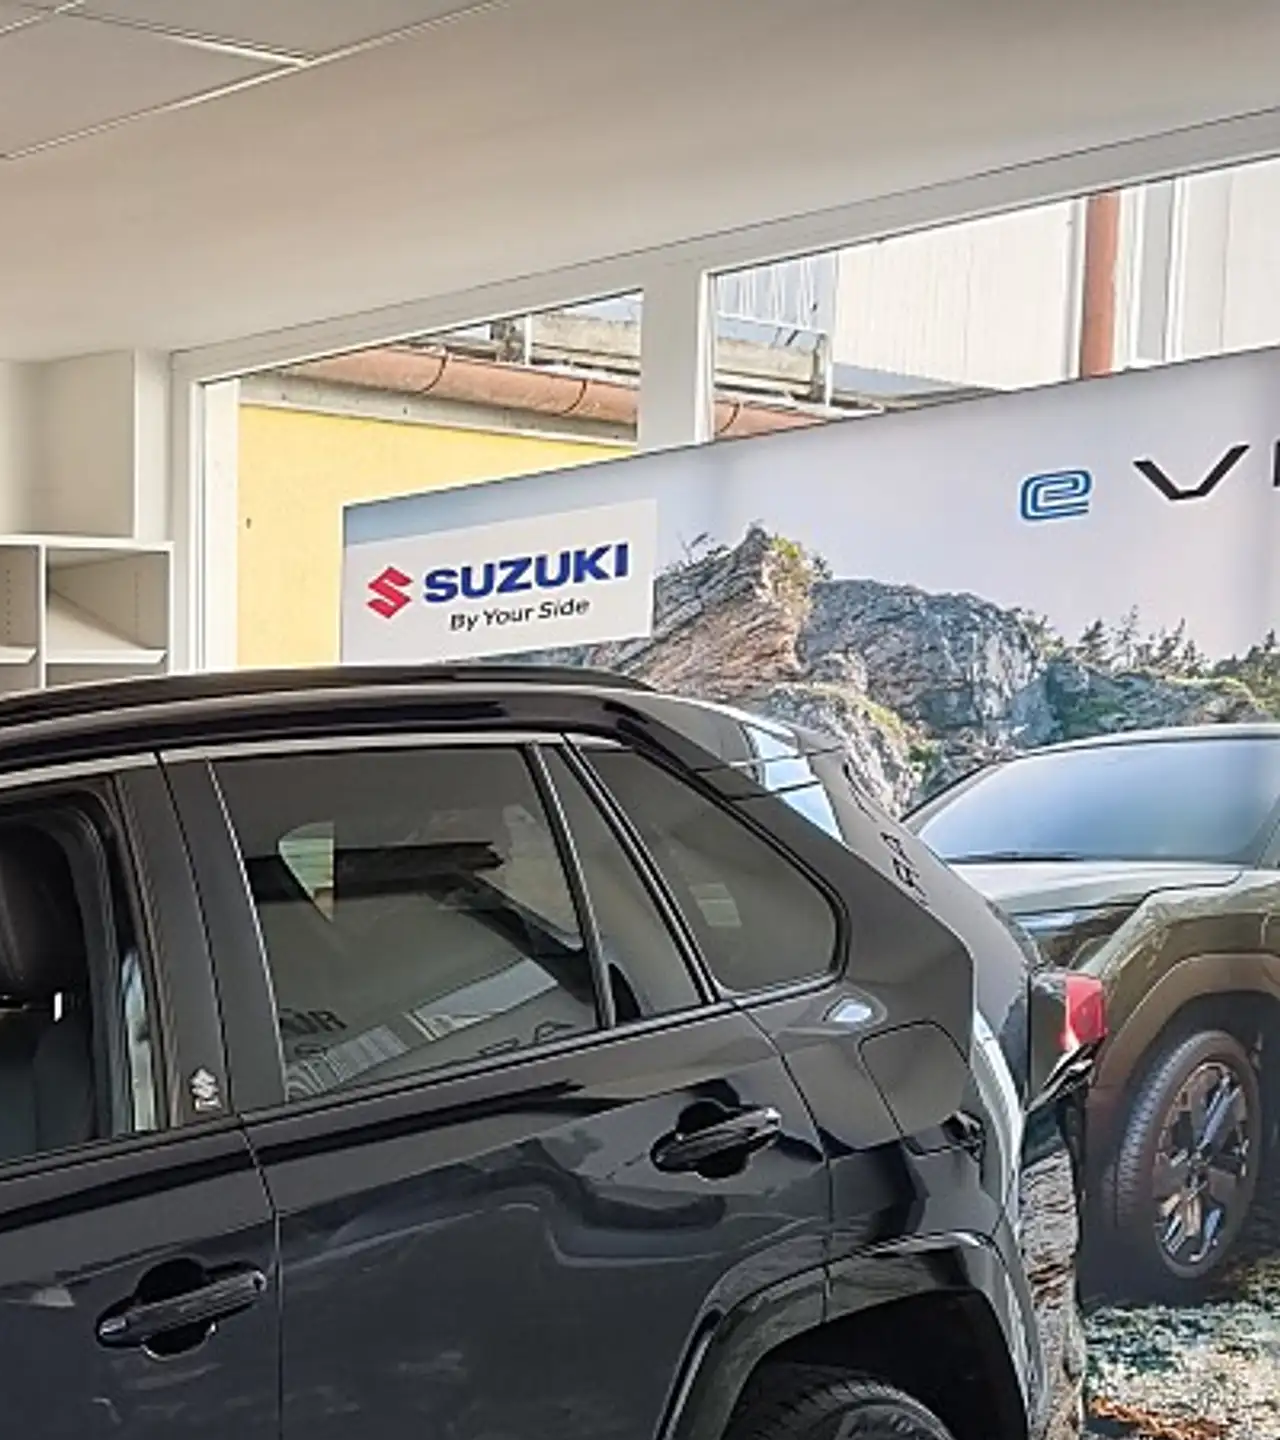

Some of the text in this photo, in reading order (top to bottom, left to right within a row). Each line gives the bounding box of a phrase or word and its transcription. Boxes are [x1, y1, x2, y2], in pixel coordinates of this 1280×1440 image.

[423, 543, 629, 603] SUZUKI
[450, 599, 590, 631] By Your Side
